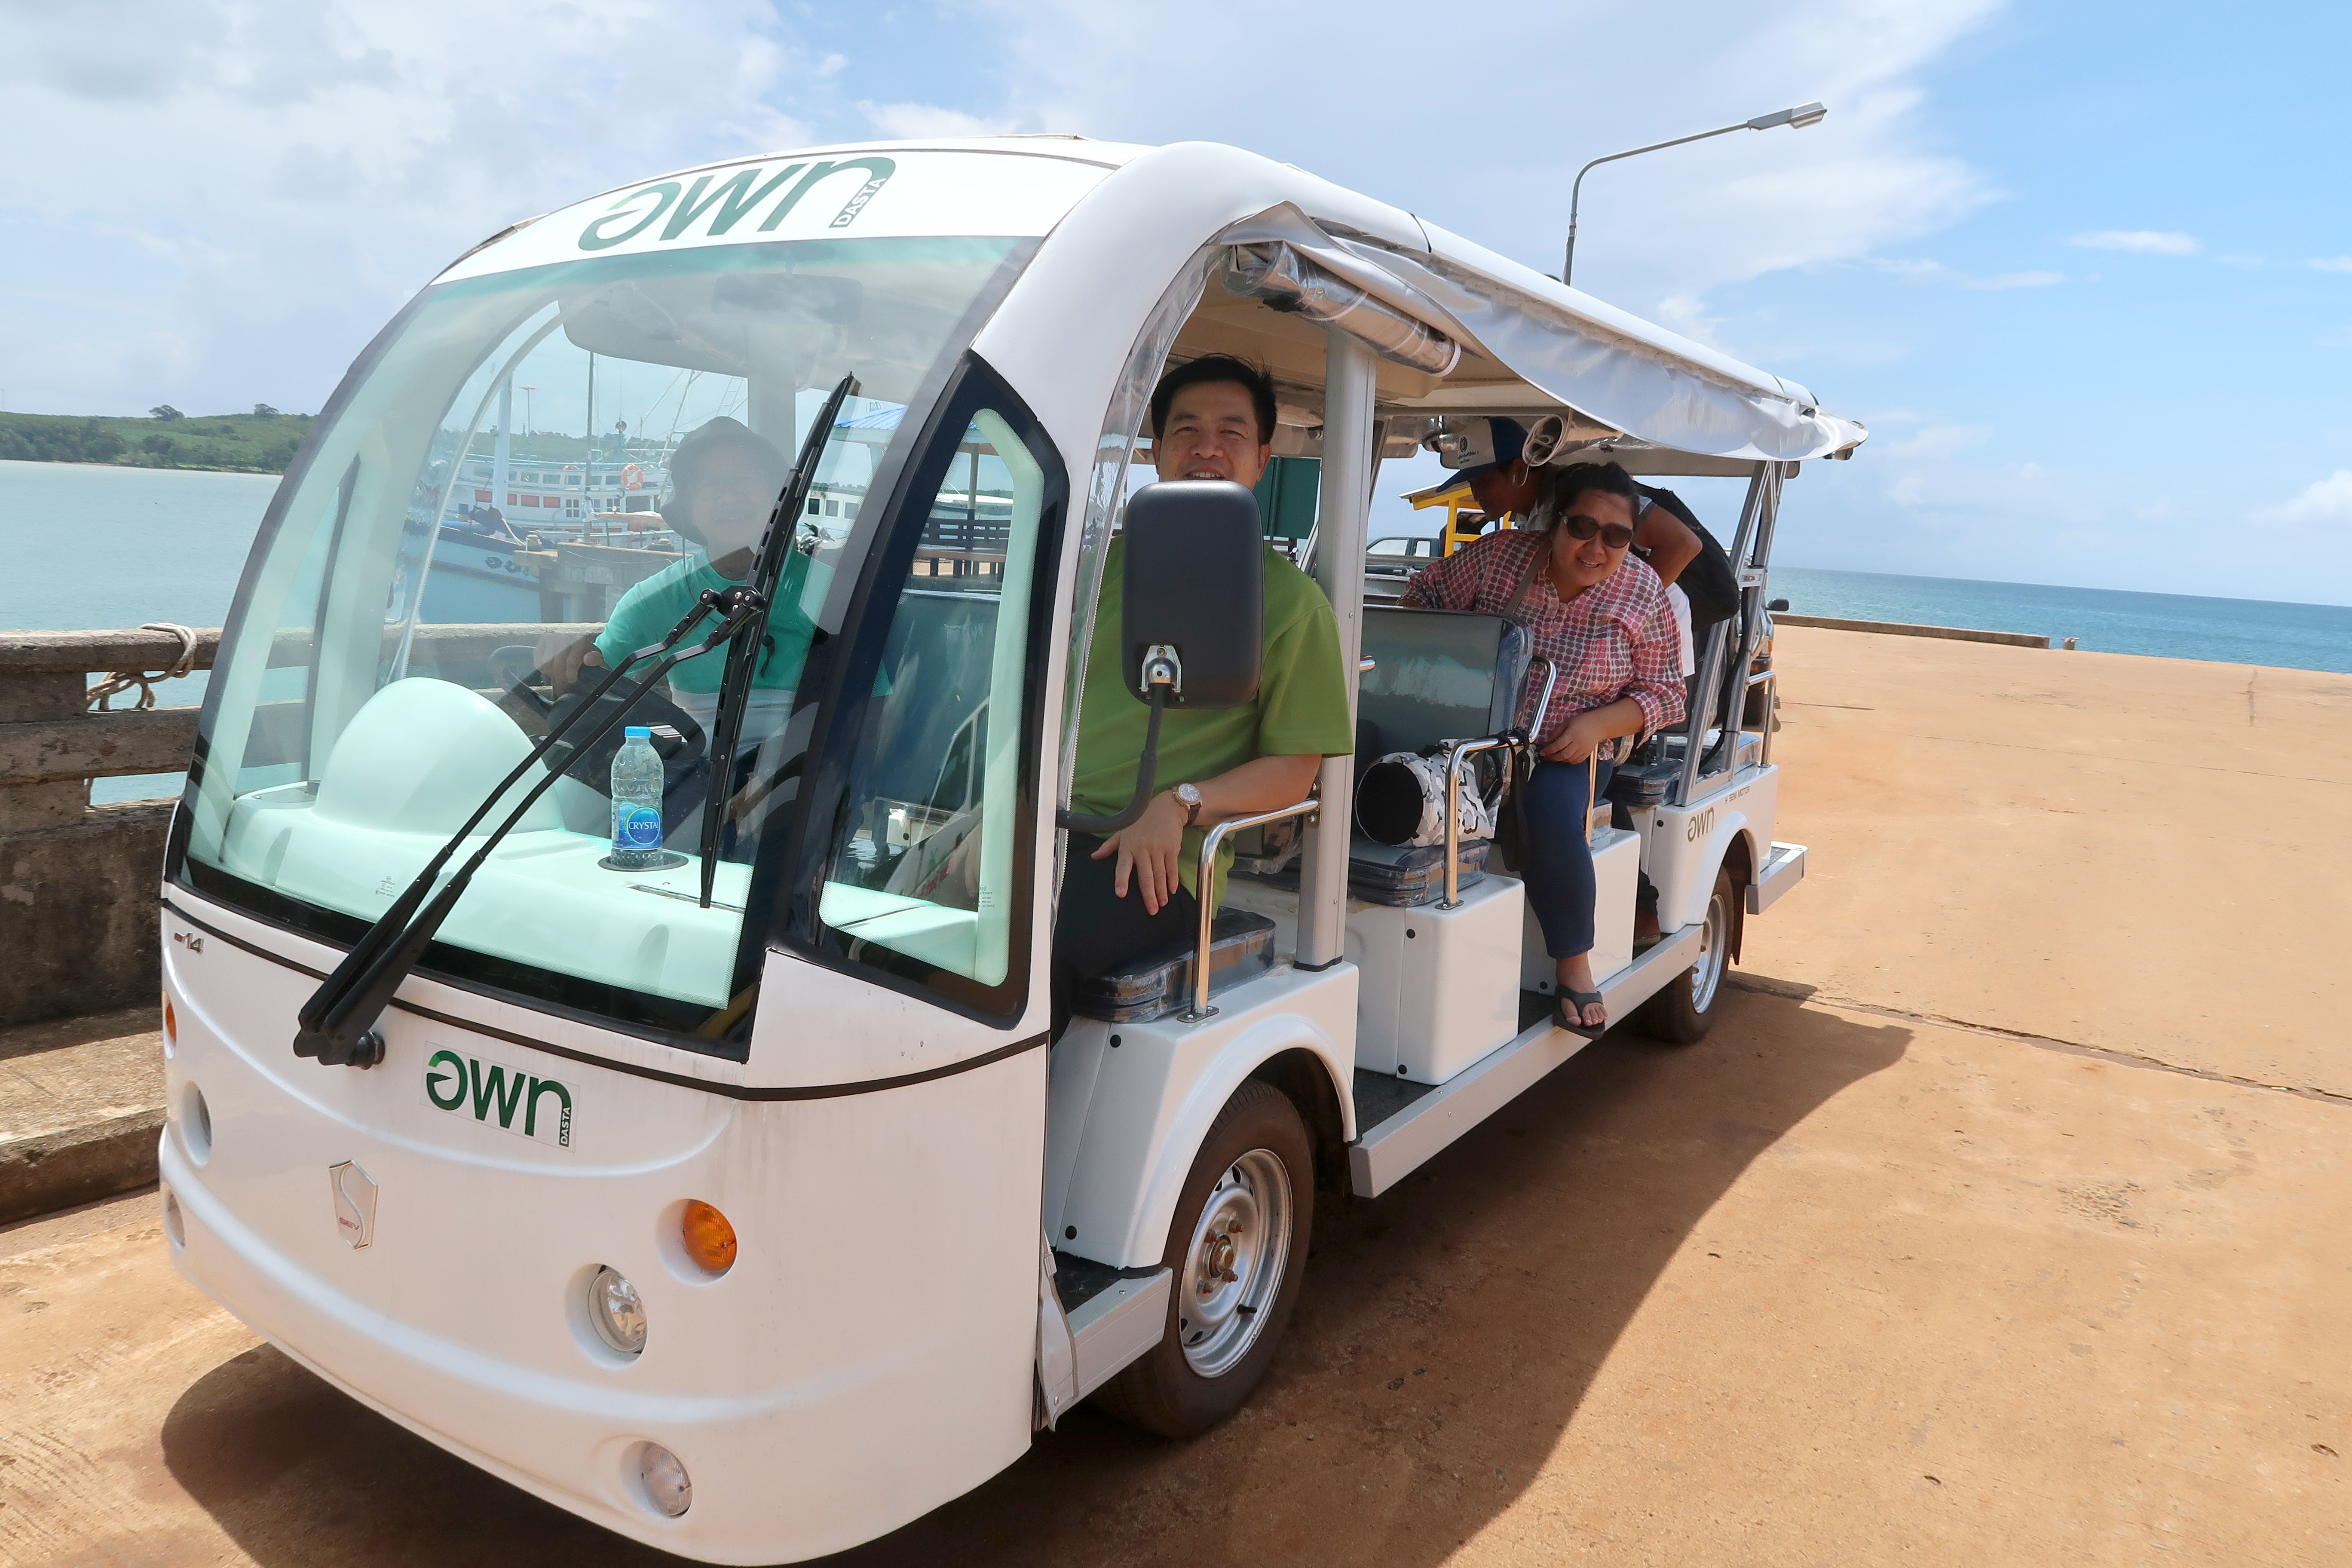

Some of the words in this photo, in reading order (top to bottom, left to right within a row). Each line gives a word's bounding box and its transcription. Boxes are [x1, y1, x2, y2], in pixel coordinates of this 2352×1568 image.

[833, 178, 886, 225] DASTA
[628, 821, 658, 830] CRYSTAL
[560, 1107, 571, 1145] DASTA
